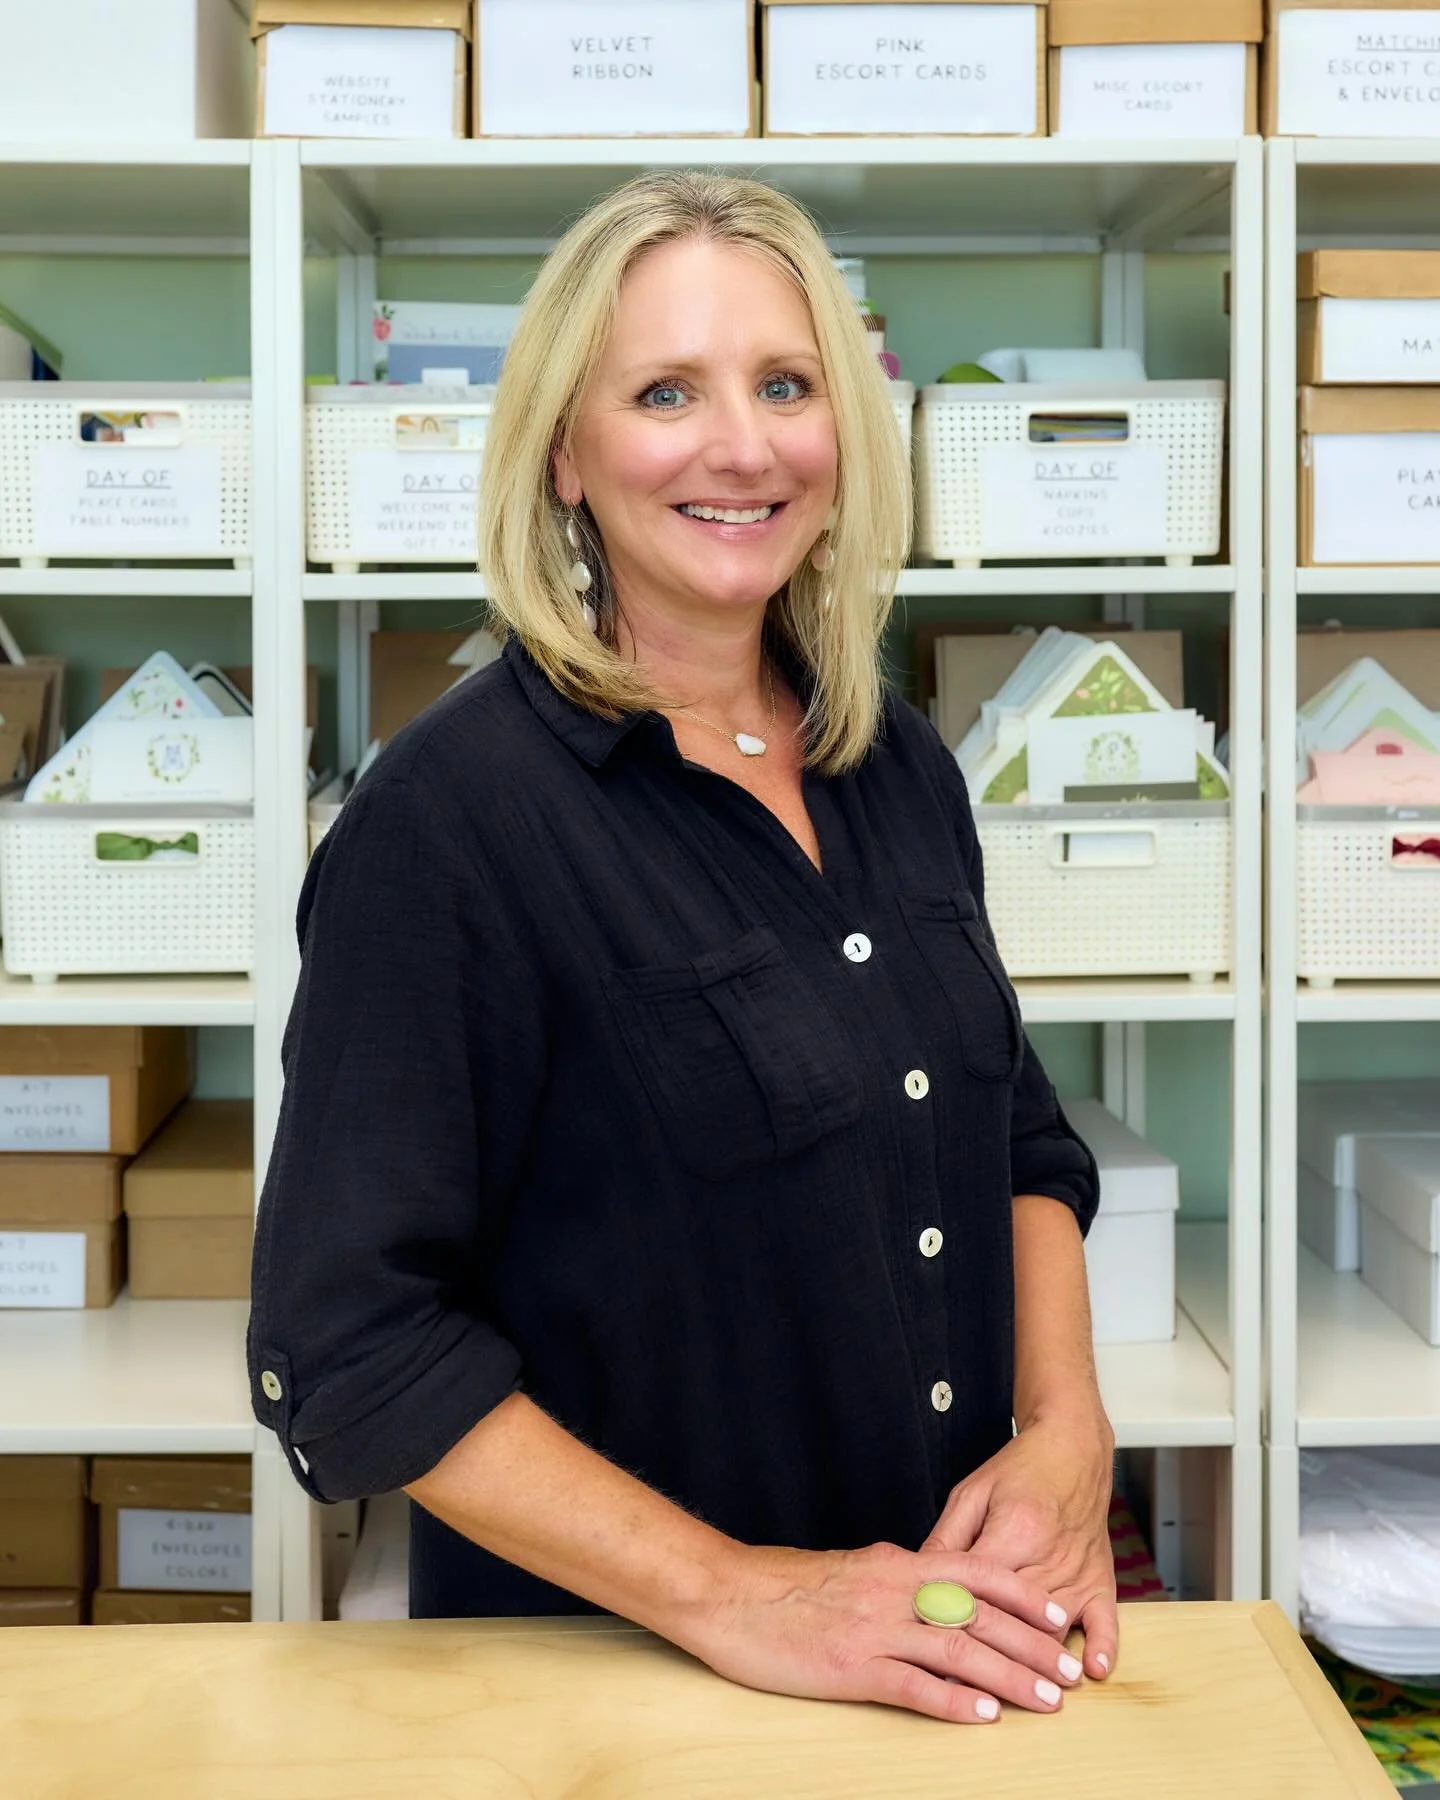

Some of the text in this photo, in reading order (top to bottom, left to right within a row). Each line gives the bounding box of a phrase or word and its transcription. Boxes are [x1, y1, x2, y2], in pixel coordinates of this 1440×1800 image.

[570, 36, 654, 53] VELVET
[875, 37, 927, 53] PINK
[572, 63, 654, 79] RIBBON
[815, 63, 987, 81] ESCORT CARDS
[1327, 58, 1411, 76] ESCORT
[324, 75, 391, 89] WEBSITE
[1143, 80, 1205, 94] ESCORT
[308, 92, 407, 107] STATIONERY
[1338, 86, 1440, 103] & ENVELO
[1123, 98, 1174, 112] CARDS
[323, 110, 391, 126] SAMPLES
[1402, 337, 1440, 354] MA
[86, 468, 172, 487] DAY OF
[1034, 461, 1118, 479] DAY OF
[402, 473, 479, 491] DAY O
[78, 496, 178, 510] PLACE CARDS
[1043, 488, 1108, 502] NAPKINS
[380, 502, 452, 514] WELCOME
[1057, 506, 1095, 519] CUPS
[69, 514, 191, 528] TABLE NUMBERS
[376, 519, 447, 532] WEEKEND
[402, 537, 438, 550] GIFT
[13, 1125, 79, 1140] COLORS
[151, 1541, 243, 1559] ENVELOPES
[165, 1564, 229, 1580] COLORS
